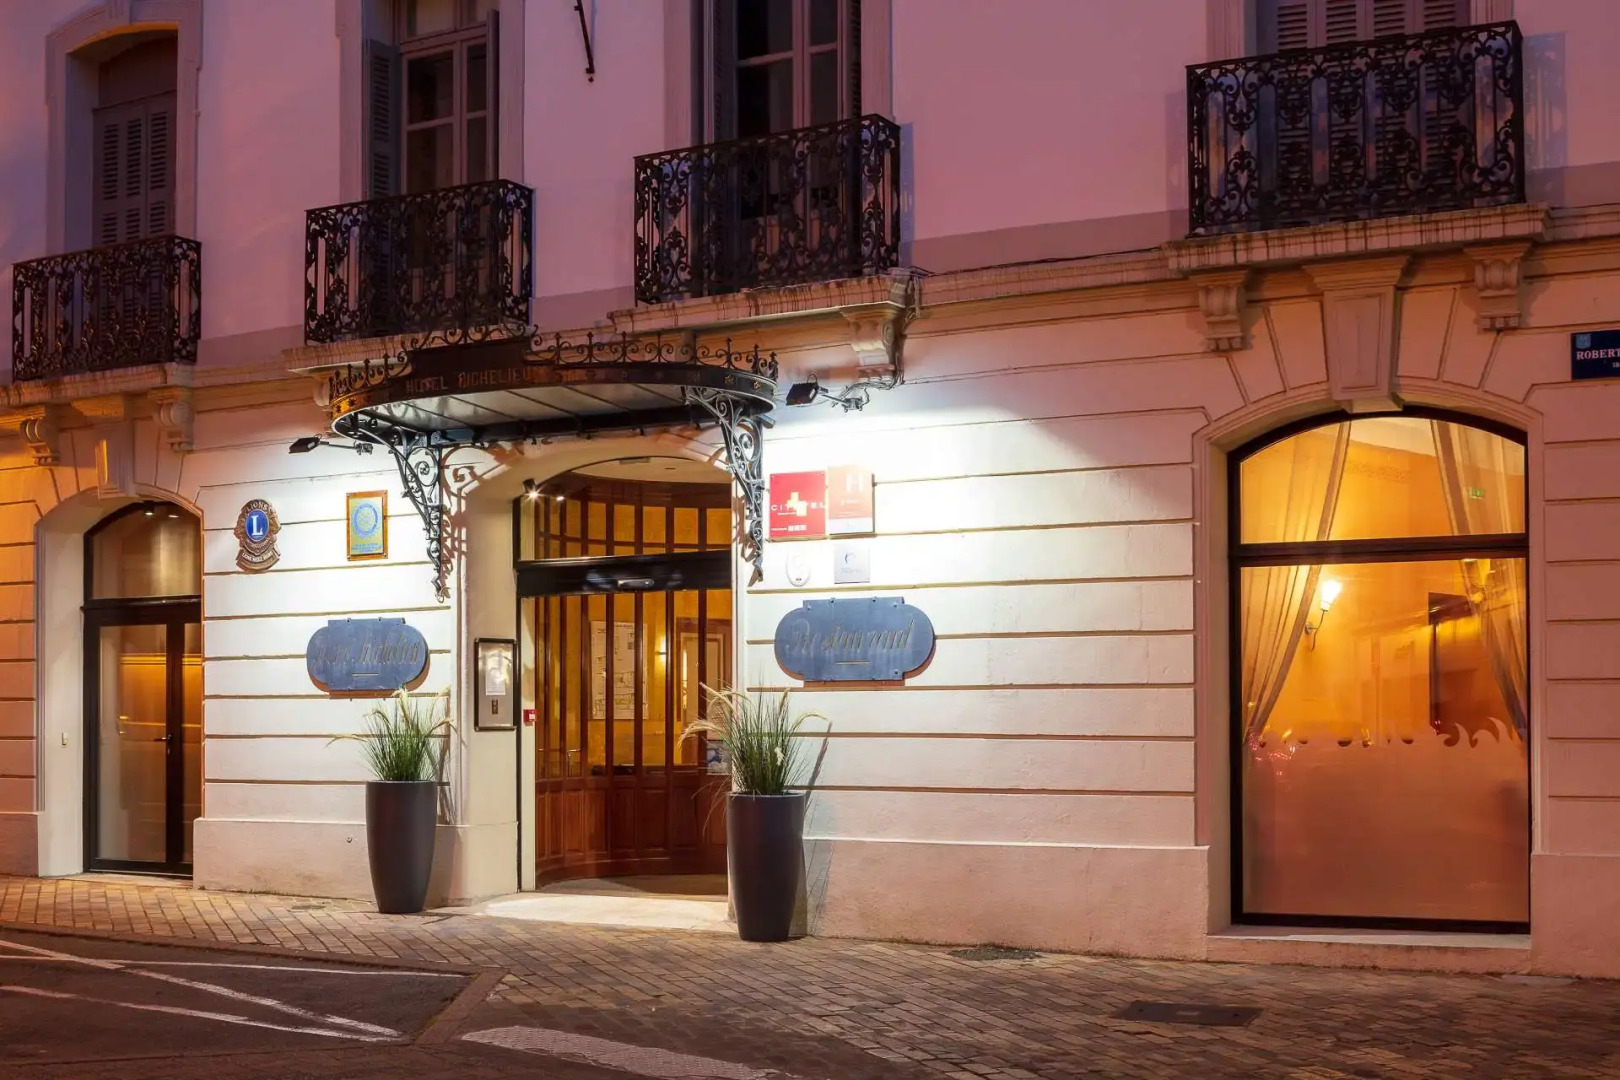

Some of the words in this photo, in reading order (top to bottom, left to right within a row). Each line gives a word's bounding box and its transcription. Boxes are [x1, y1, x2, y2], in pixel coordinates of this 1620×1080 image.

[1576, 349, 1620, 360] ROBERT
[405, 376, 448, 394] HOTEL
[246, 501, 268, 513] LIONS
[251, 515, 264, 536] L
